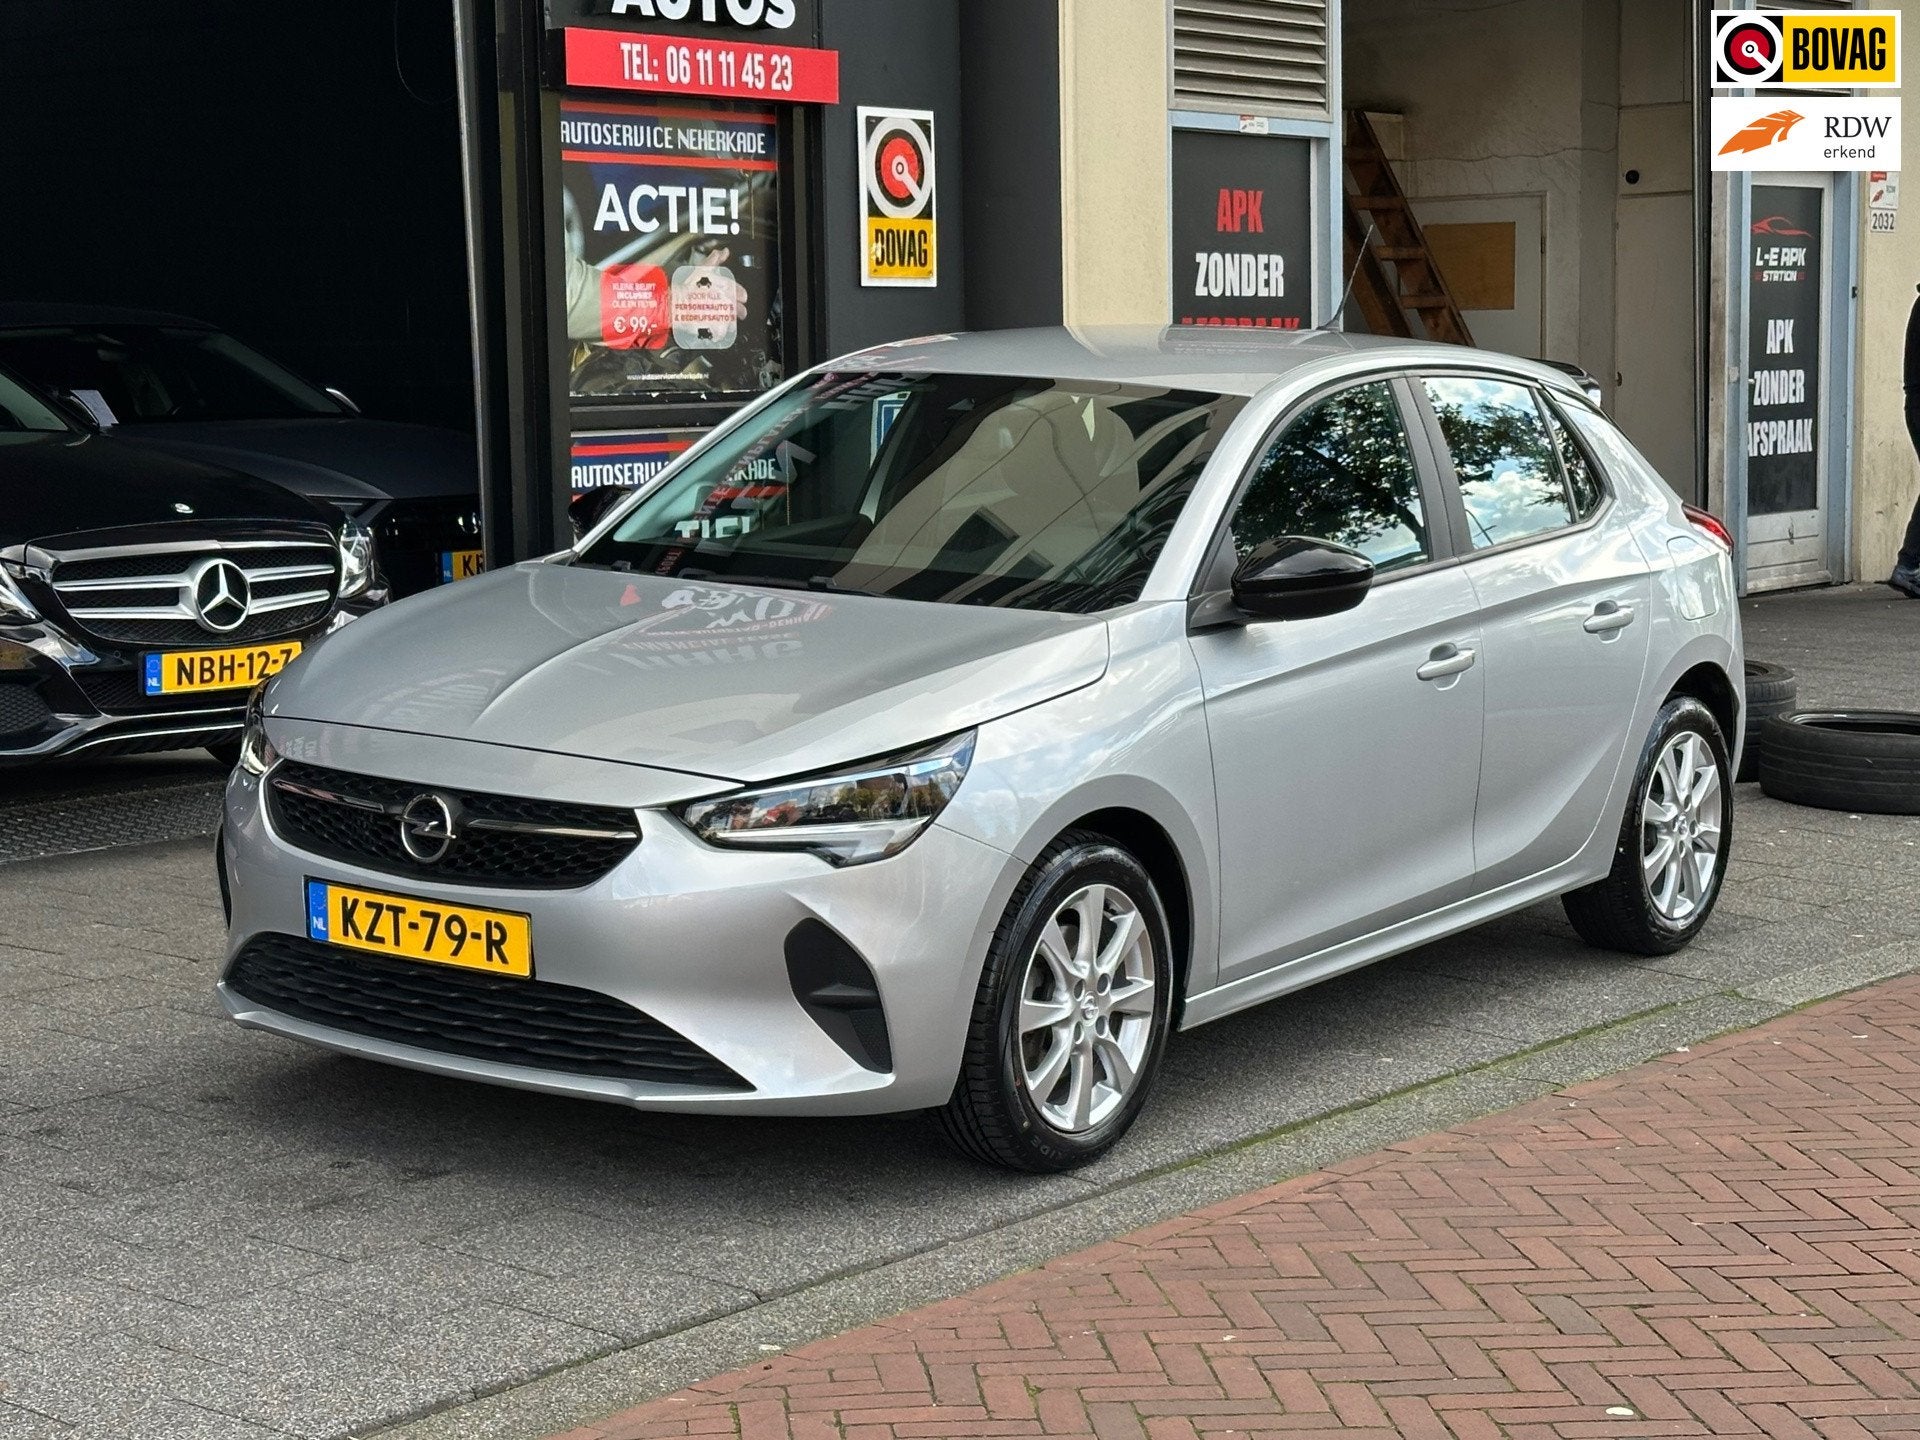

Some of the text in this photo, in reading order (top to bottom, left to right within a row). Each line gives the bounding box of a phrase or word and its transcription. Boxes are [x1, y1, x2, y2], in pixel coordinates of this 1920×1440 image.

[620, 42, 793, 92] TEL: 06 11 11 45 23
[560, 120, 766, 154] AUTOSERVICE NEHERKADE
[593, 183, 741, 235] ACTIE!
[1216, 188, 1264, 233] APK
[1872, 213, 1895, 230] 2032
[875, 228, 928, 268] BOVAG
[1195, 252, 1285, 297] ZONDER
[1762, 270, 1797, 281] STATION
[1766, 319, 1795, 354] APK
[1753, 369, 1805, 406] ZONDER
[148, 679, 160, 687] NL
[313, 896, 509, 965] NL KZT-79-R
